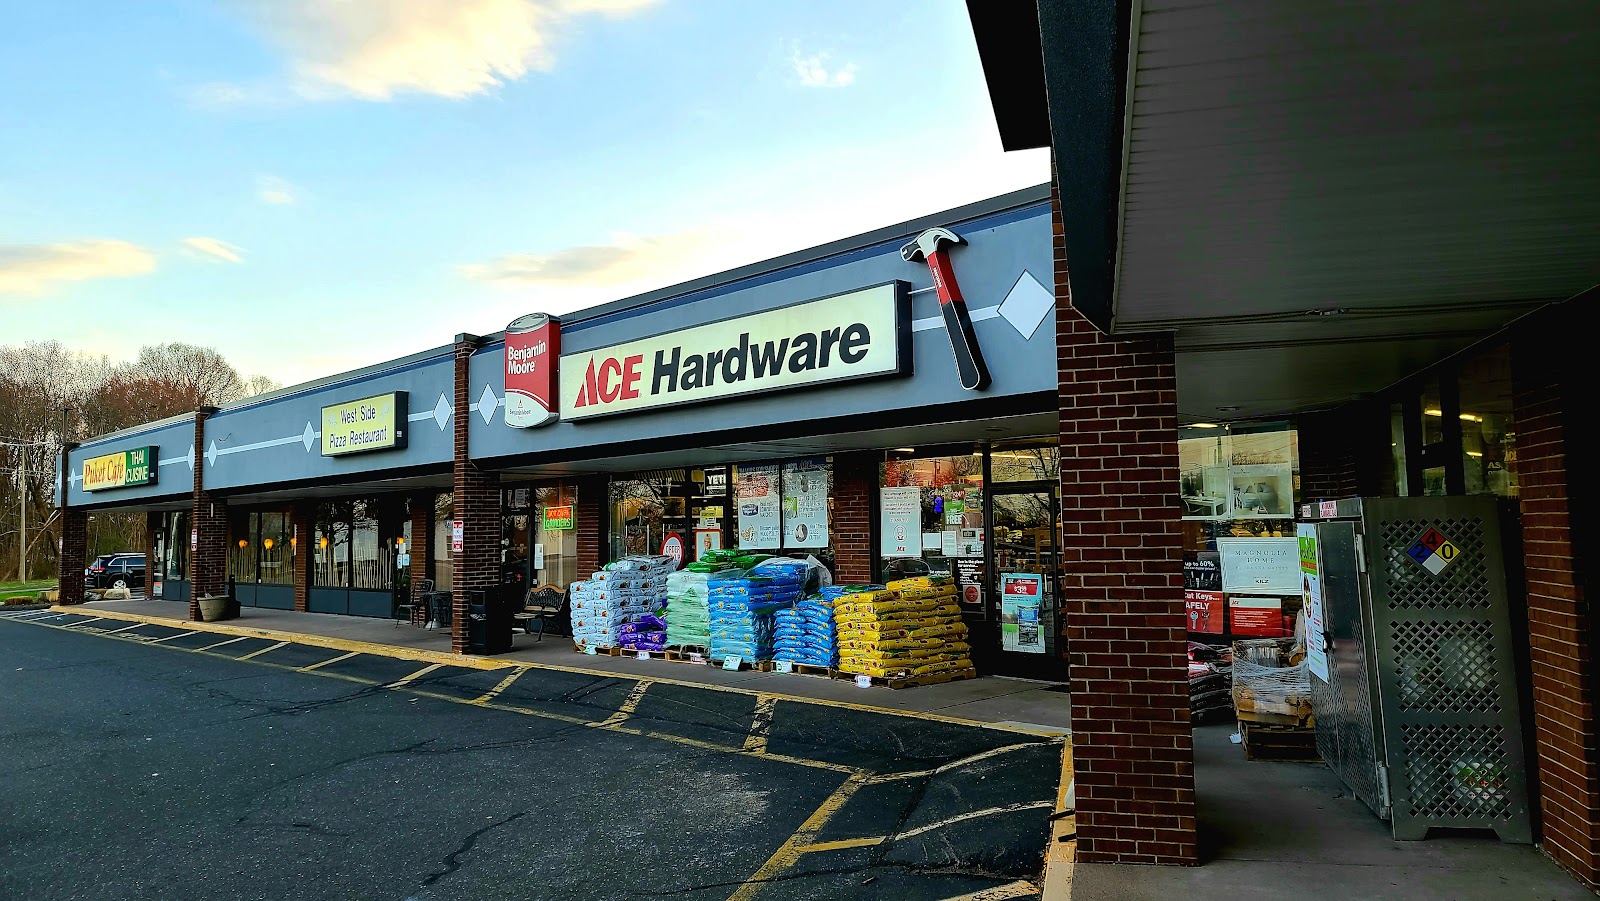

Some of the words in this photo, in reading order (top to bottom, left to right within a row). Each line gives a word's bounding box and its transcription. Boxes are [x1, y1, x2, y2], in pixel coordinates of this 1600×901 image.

[508, 340, 546, 362] Benjamin
[508, 360, 535, 374] Moore
[574, 354, 644, 408] ACE
[650, 322, 871, 395] Hardware
[340, 408, 358, 424] West
[360, 404, 376, 421] Side
[329, 433, 347, 448] Pizza
[349, 425, 387, 446] Restaurant
[130, 449, 145, 465] THAI
[84, 461, 106, 485] Puket
[125, 466, 148, 482] CUISINE
[707, 474, 727, 485] YETI
[946, 514, 962, 525] FREE
[1426, 532, 1437, 547] 4
[1413, 543, 1426, 558] 2
[1441, 543, 1454, 560] 0
[1185, 601, 1210, 610] AFELY
